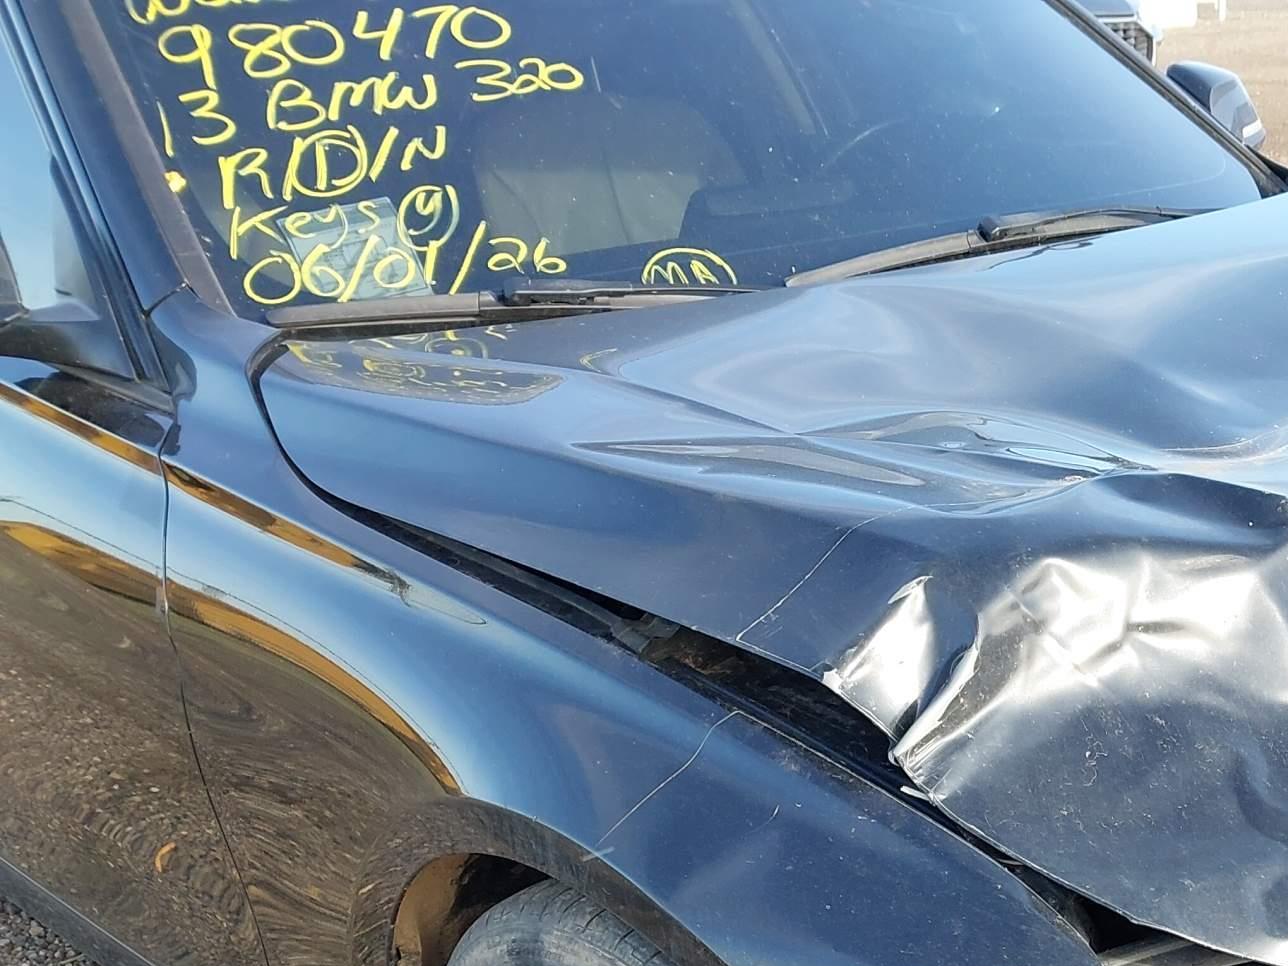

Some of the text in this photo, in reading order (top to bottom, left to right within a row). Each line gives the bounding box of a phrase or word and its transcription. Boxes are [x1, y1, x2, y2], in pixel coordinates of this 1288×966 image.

[158, 5, 512, 89] 980470
[156, 90, 237, 158] 13
[454, 57, 585, 101] 320
